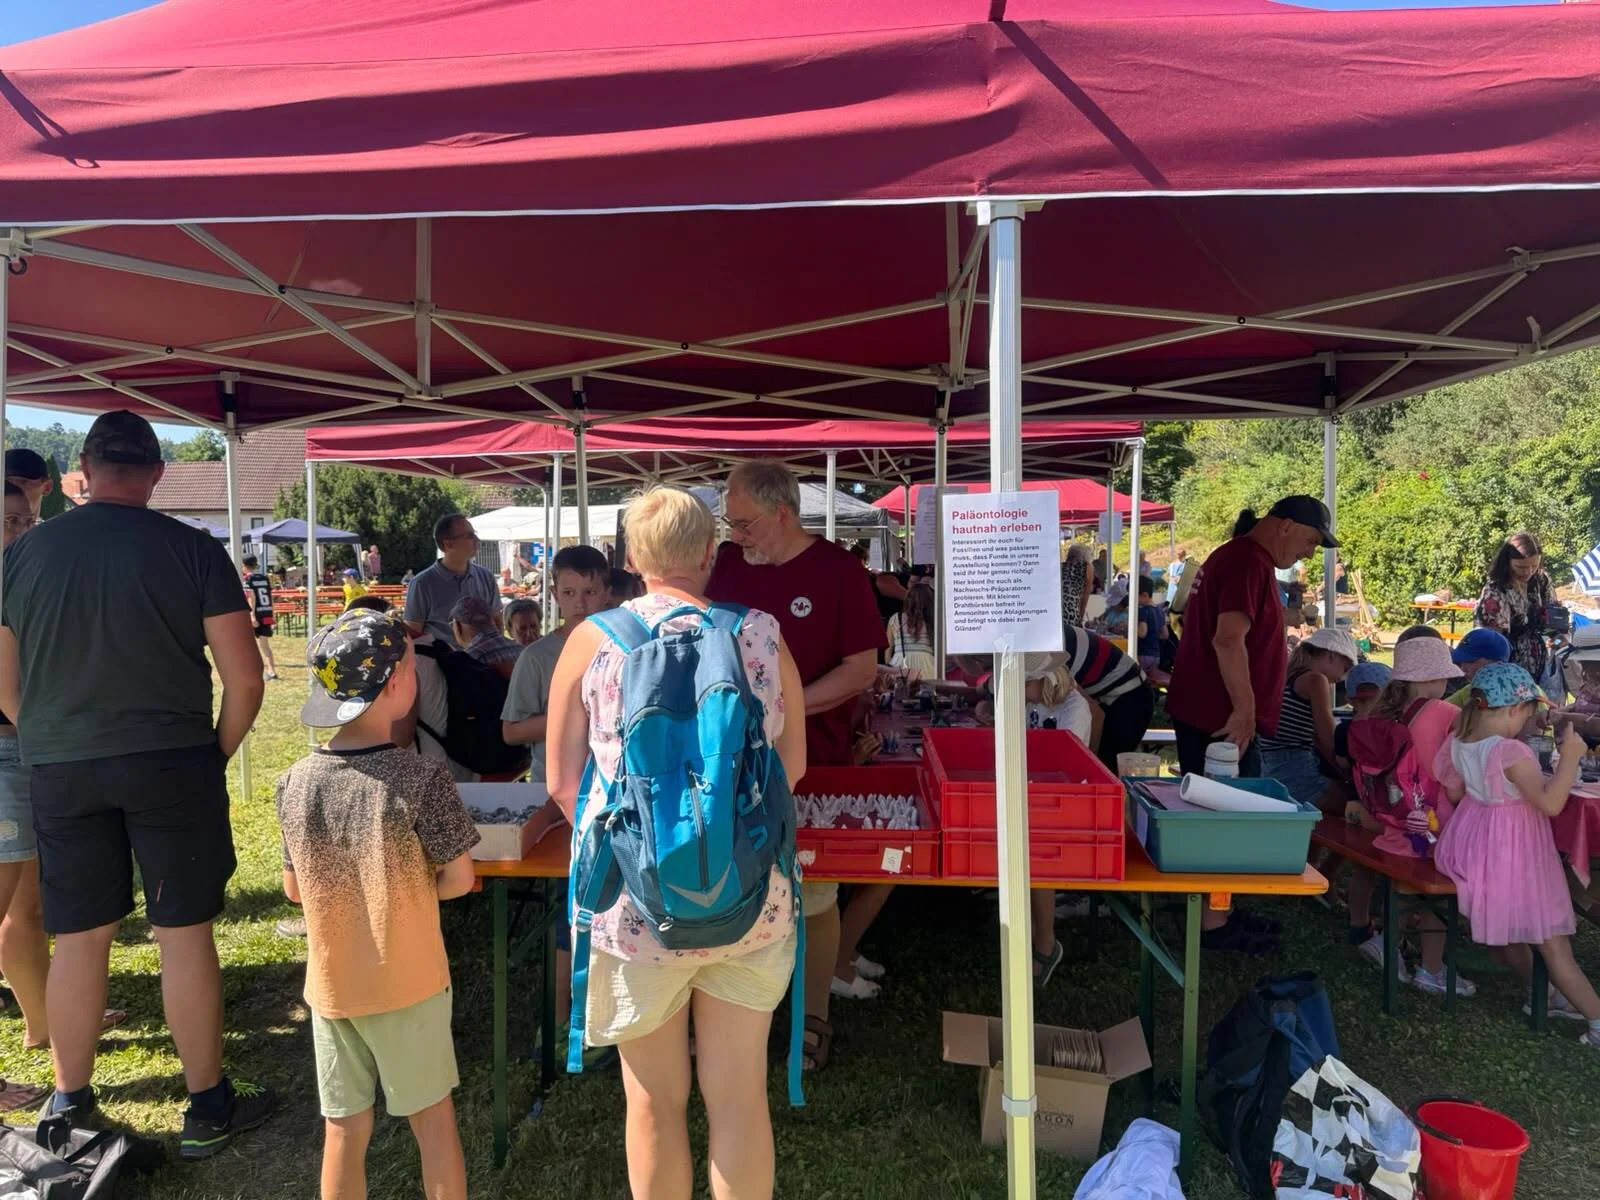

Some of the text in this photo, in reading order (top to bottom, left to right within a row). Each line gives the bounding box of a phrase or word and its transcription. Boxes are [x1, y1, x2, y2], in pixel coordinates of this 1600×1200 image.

[952, 508, 1028, 520] Paläontologie
[952, 522, 1041, 534] hautnah erleben
[258, 588, 270, 606] 6
[1034, 1113, 1074, 1127] AGON
